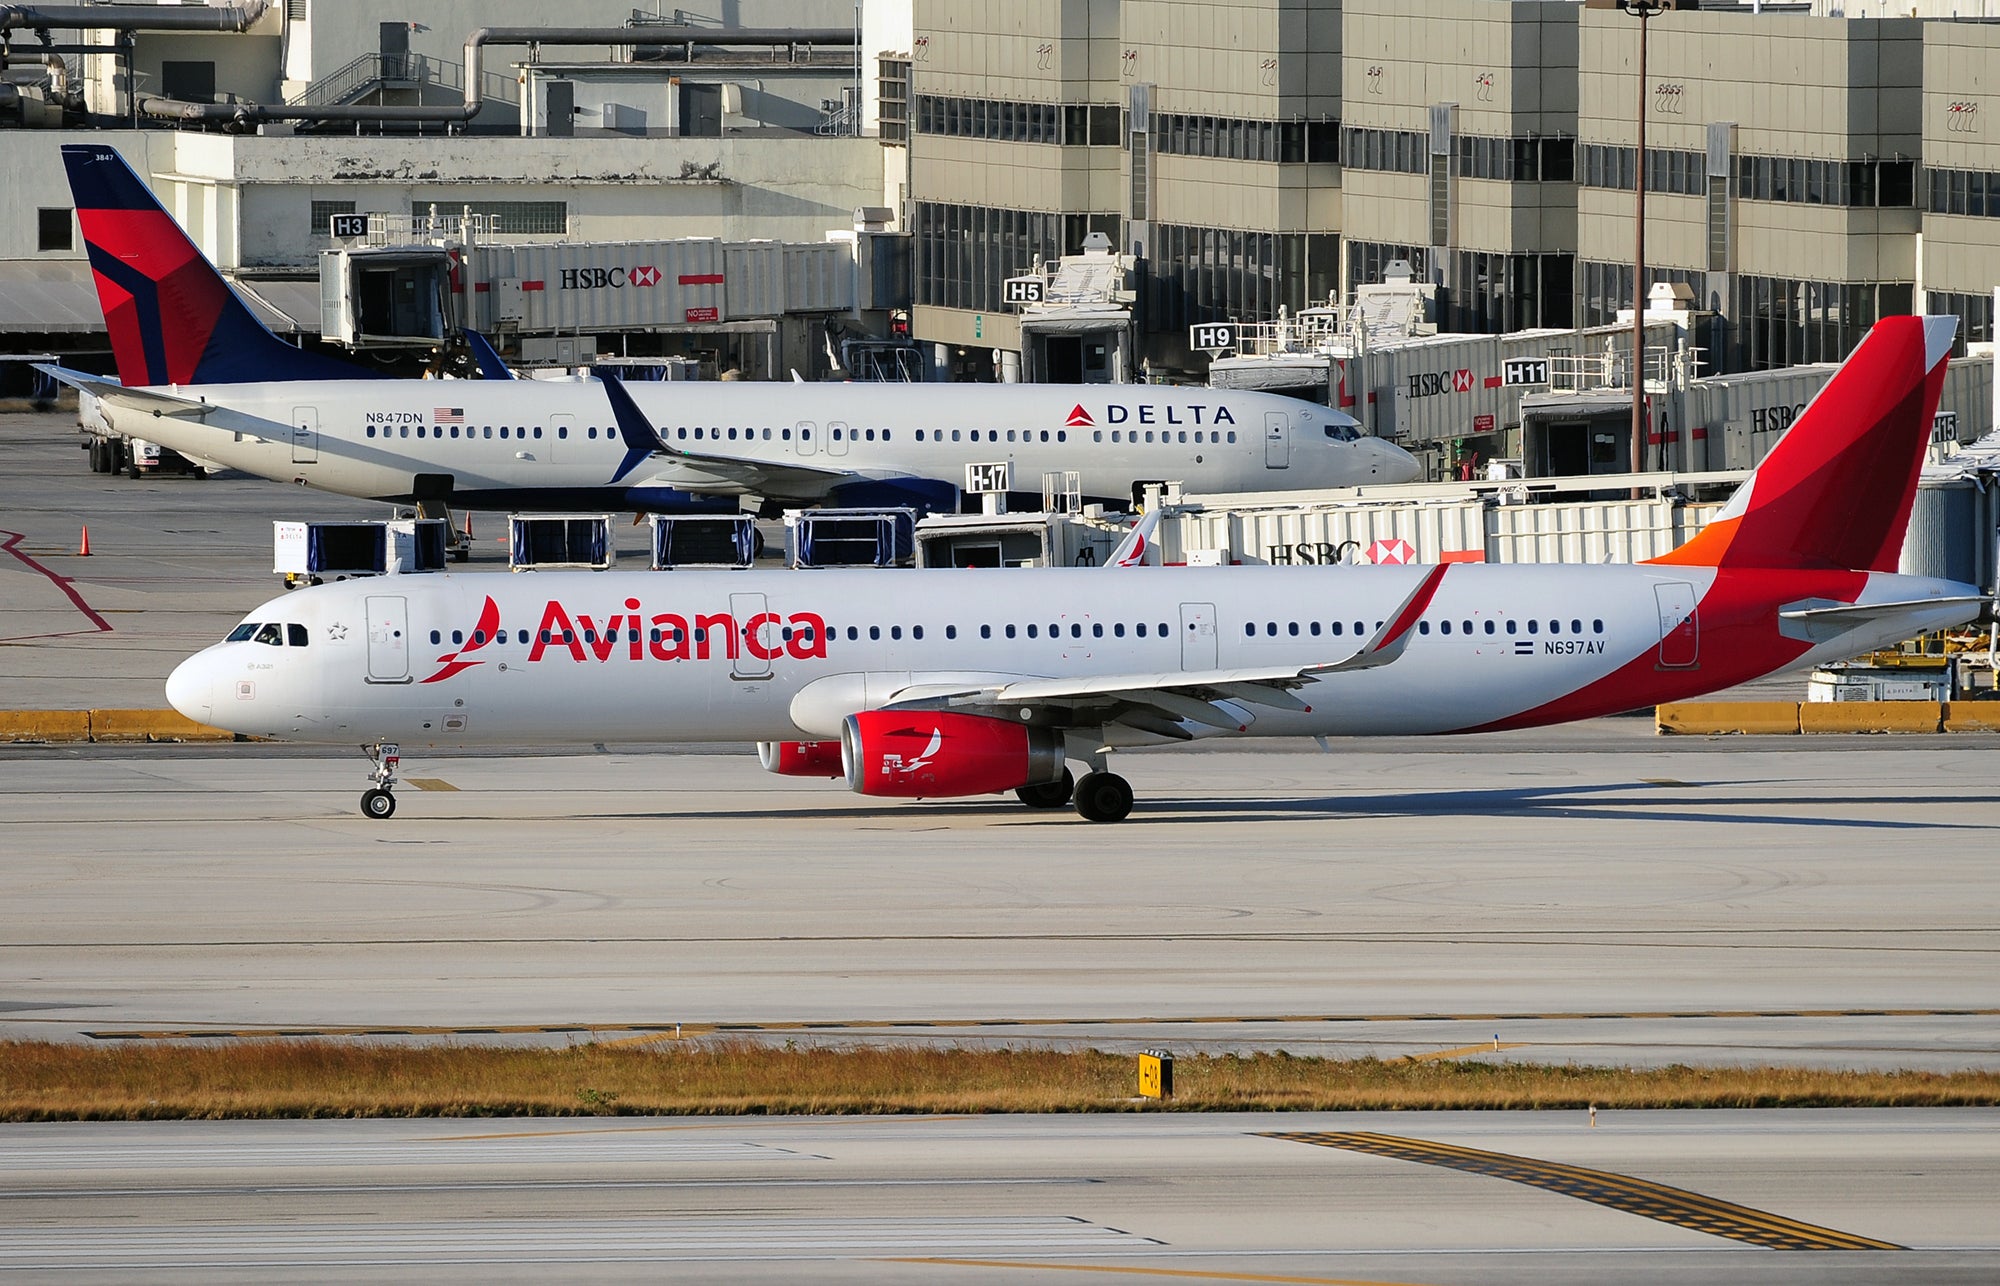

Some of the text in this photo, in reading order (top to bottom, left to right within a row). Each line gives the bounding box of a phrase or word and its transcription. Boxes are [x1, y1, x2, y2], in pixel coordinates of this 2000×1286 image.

[337, 218, 363, 235] H3
[560, 267, 626, 290] HSBC
[1011, 283, 1039, 301] H5
[1200, 328, 1230, 347] H9
[1507, 363, 1546, 383] H11
[1409, 371, 1451, 398] HSBC
[366, 413, 423, 423] N847DN
[1107, 405, 1236, 425] DELTA
[1931, 417, 1955, 443] H15
[971, 465, 1005, 491] H-17
[528, 597, 827, 662] Avianca
[1545, 641, 1605, 654] N697AV
[381, 747, 398, 755] 697
